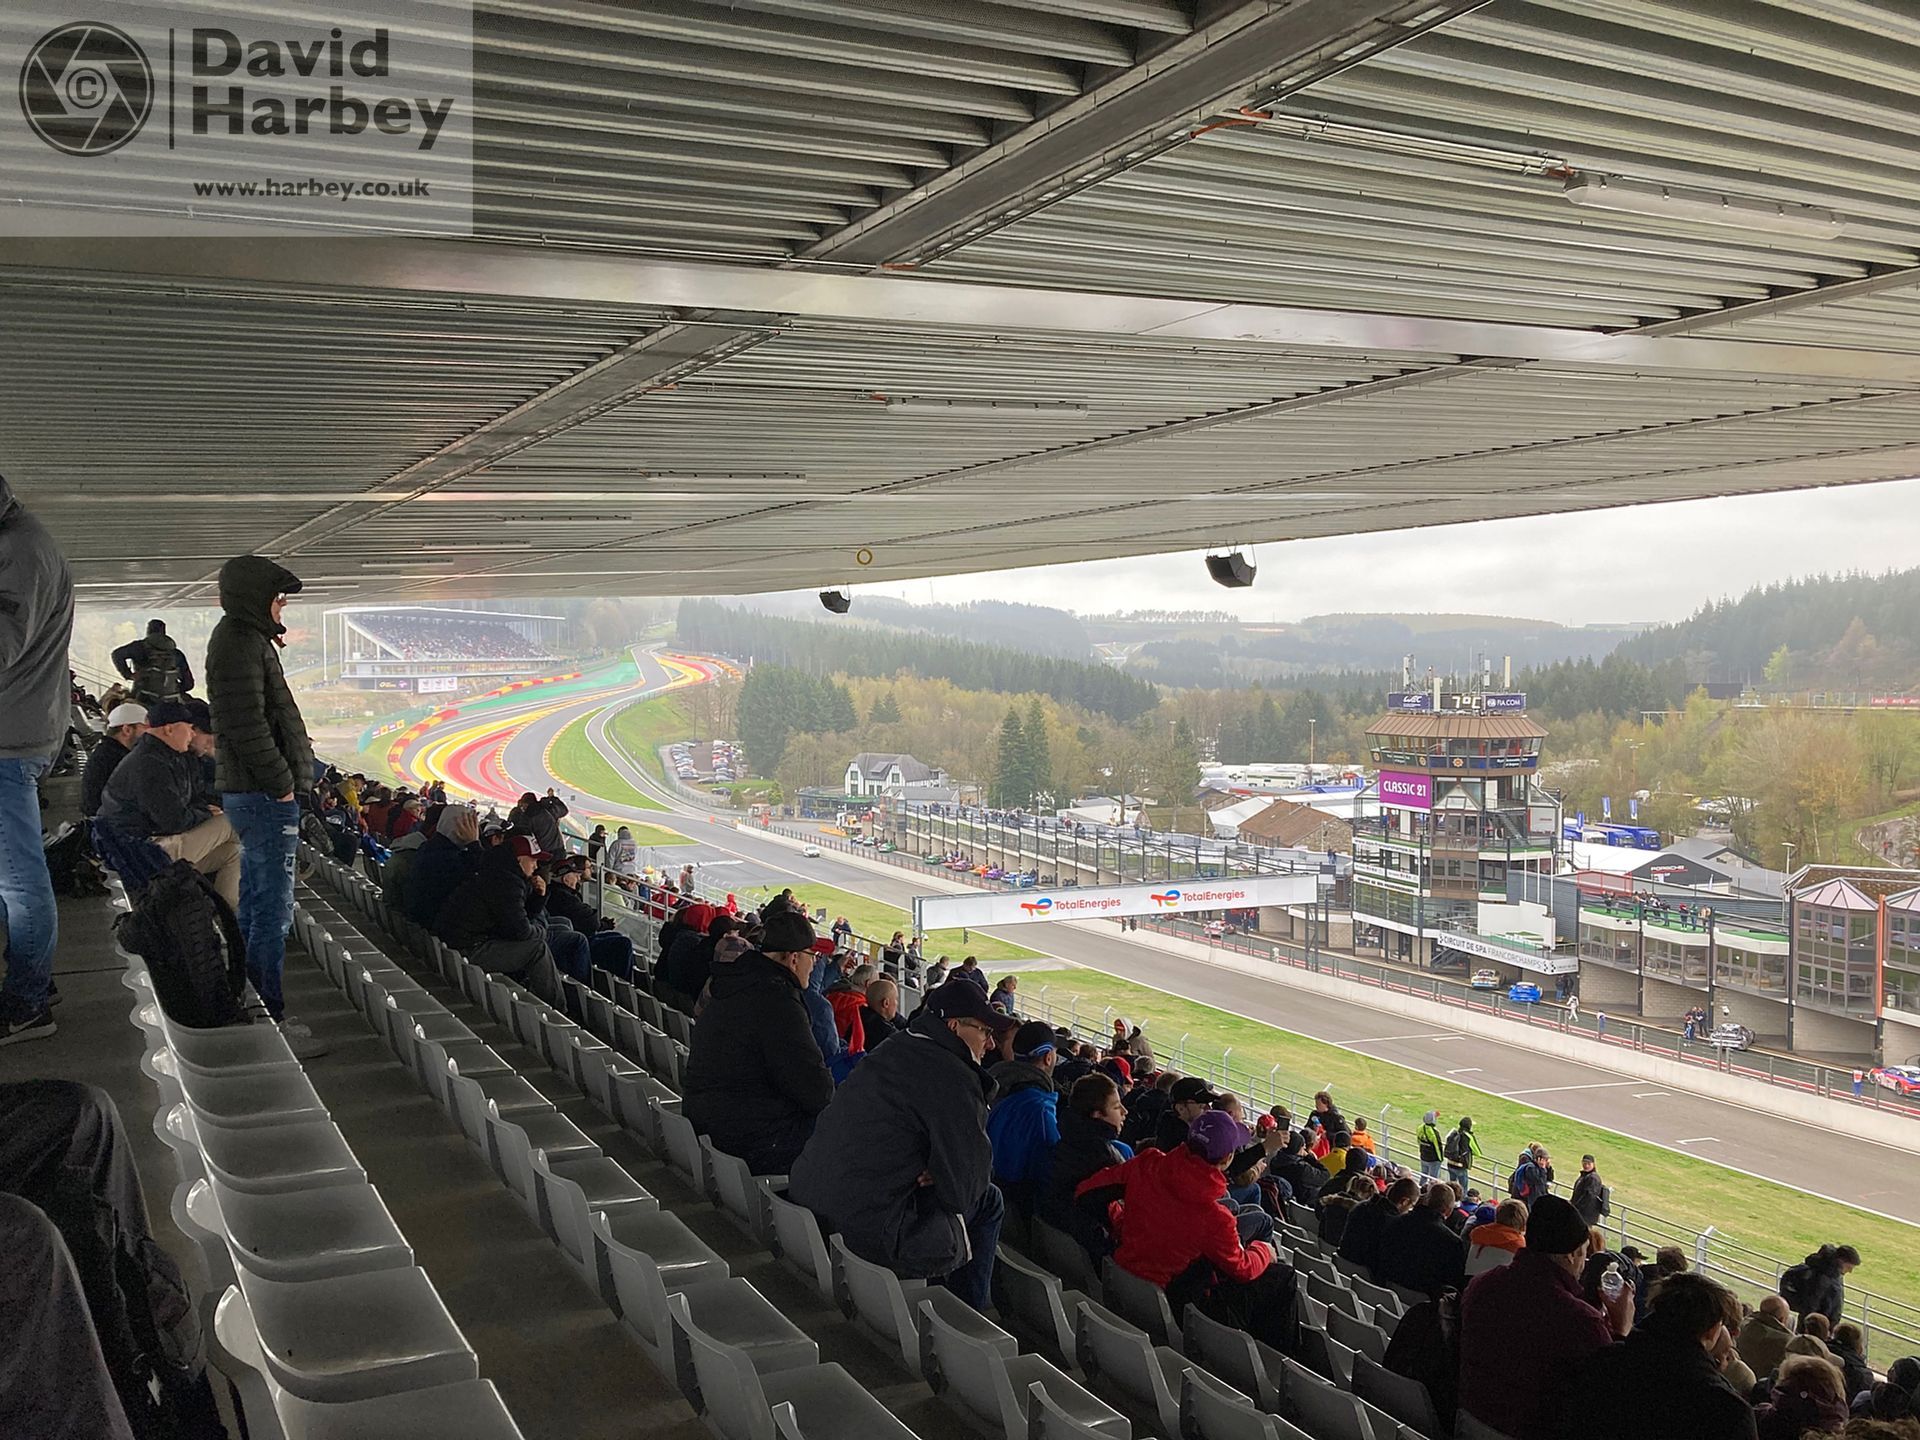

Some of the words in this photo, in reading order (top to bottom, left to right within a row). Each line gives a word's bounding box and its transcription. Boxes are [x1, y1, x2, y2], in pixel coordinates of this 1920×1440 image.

[1383, 781, 1415, 795] CLASSIC
[1416, 784, 1427, 797] 21
[1054, 897, 1121, 910] TotalEnergies
[1182, 890, 1245, 903] TotalEnergies
[1444, 936, 1465, 949] CIRCUIT
[1465, 942, 1475, 951] DE
[1475, 944, 1487, 954] SPA
[1487, 947, 1542, 969] FRANCORCHAMPS
